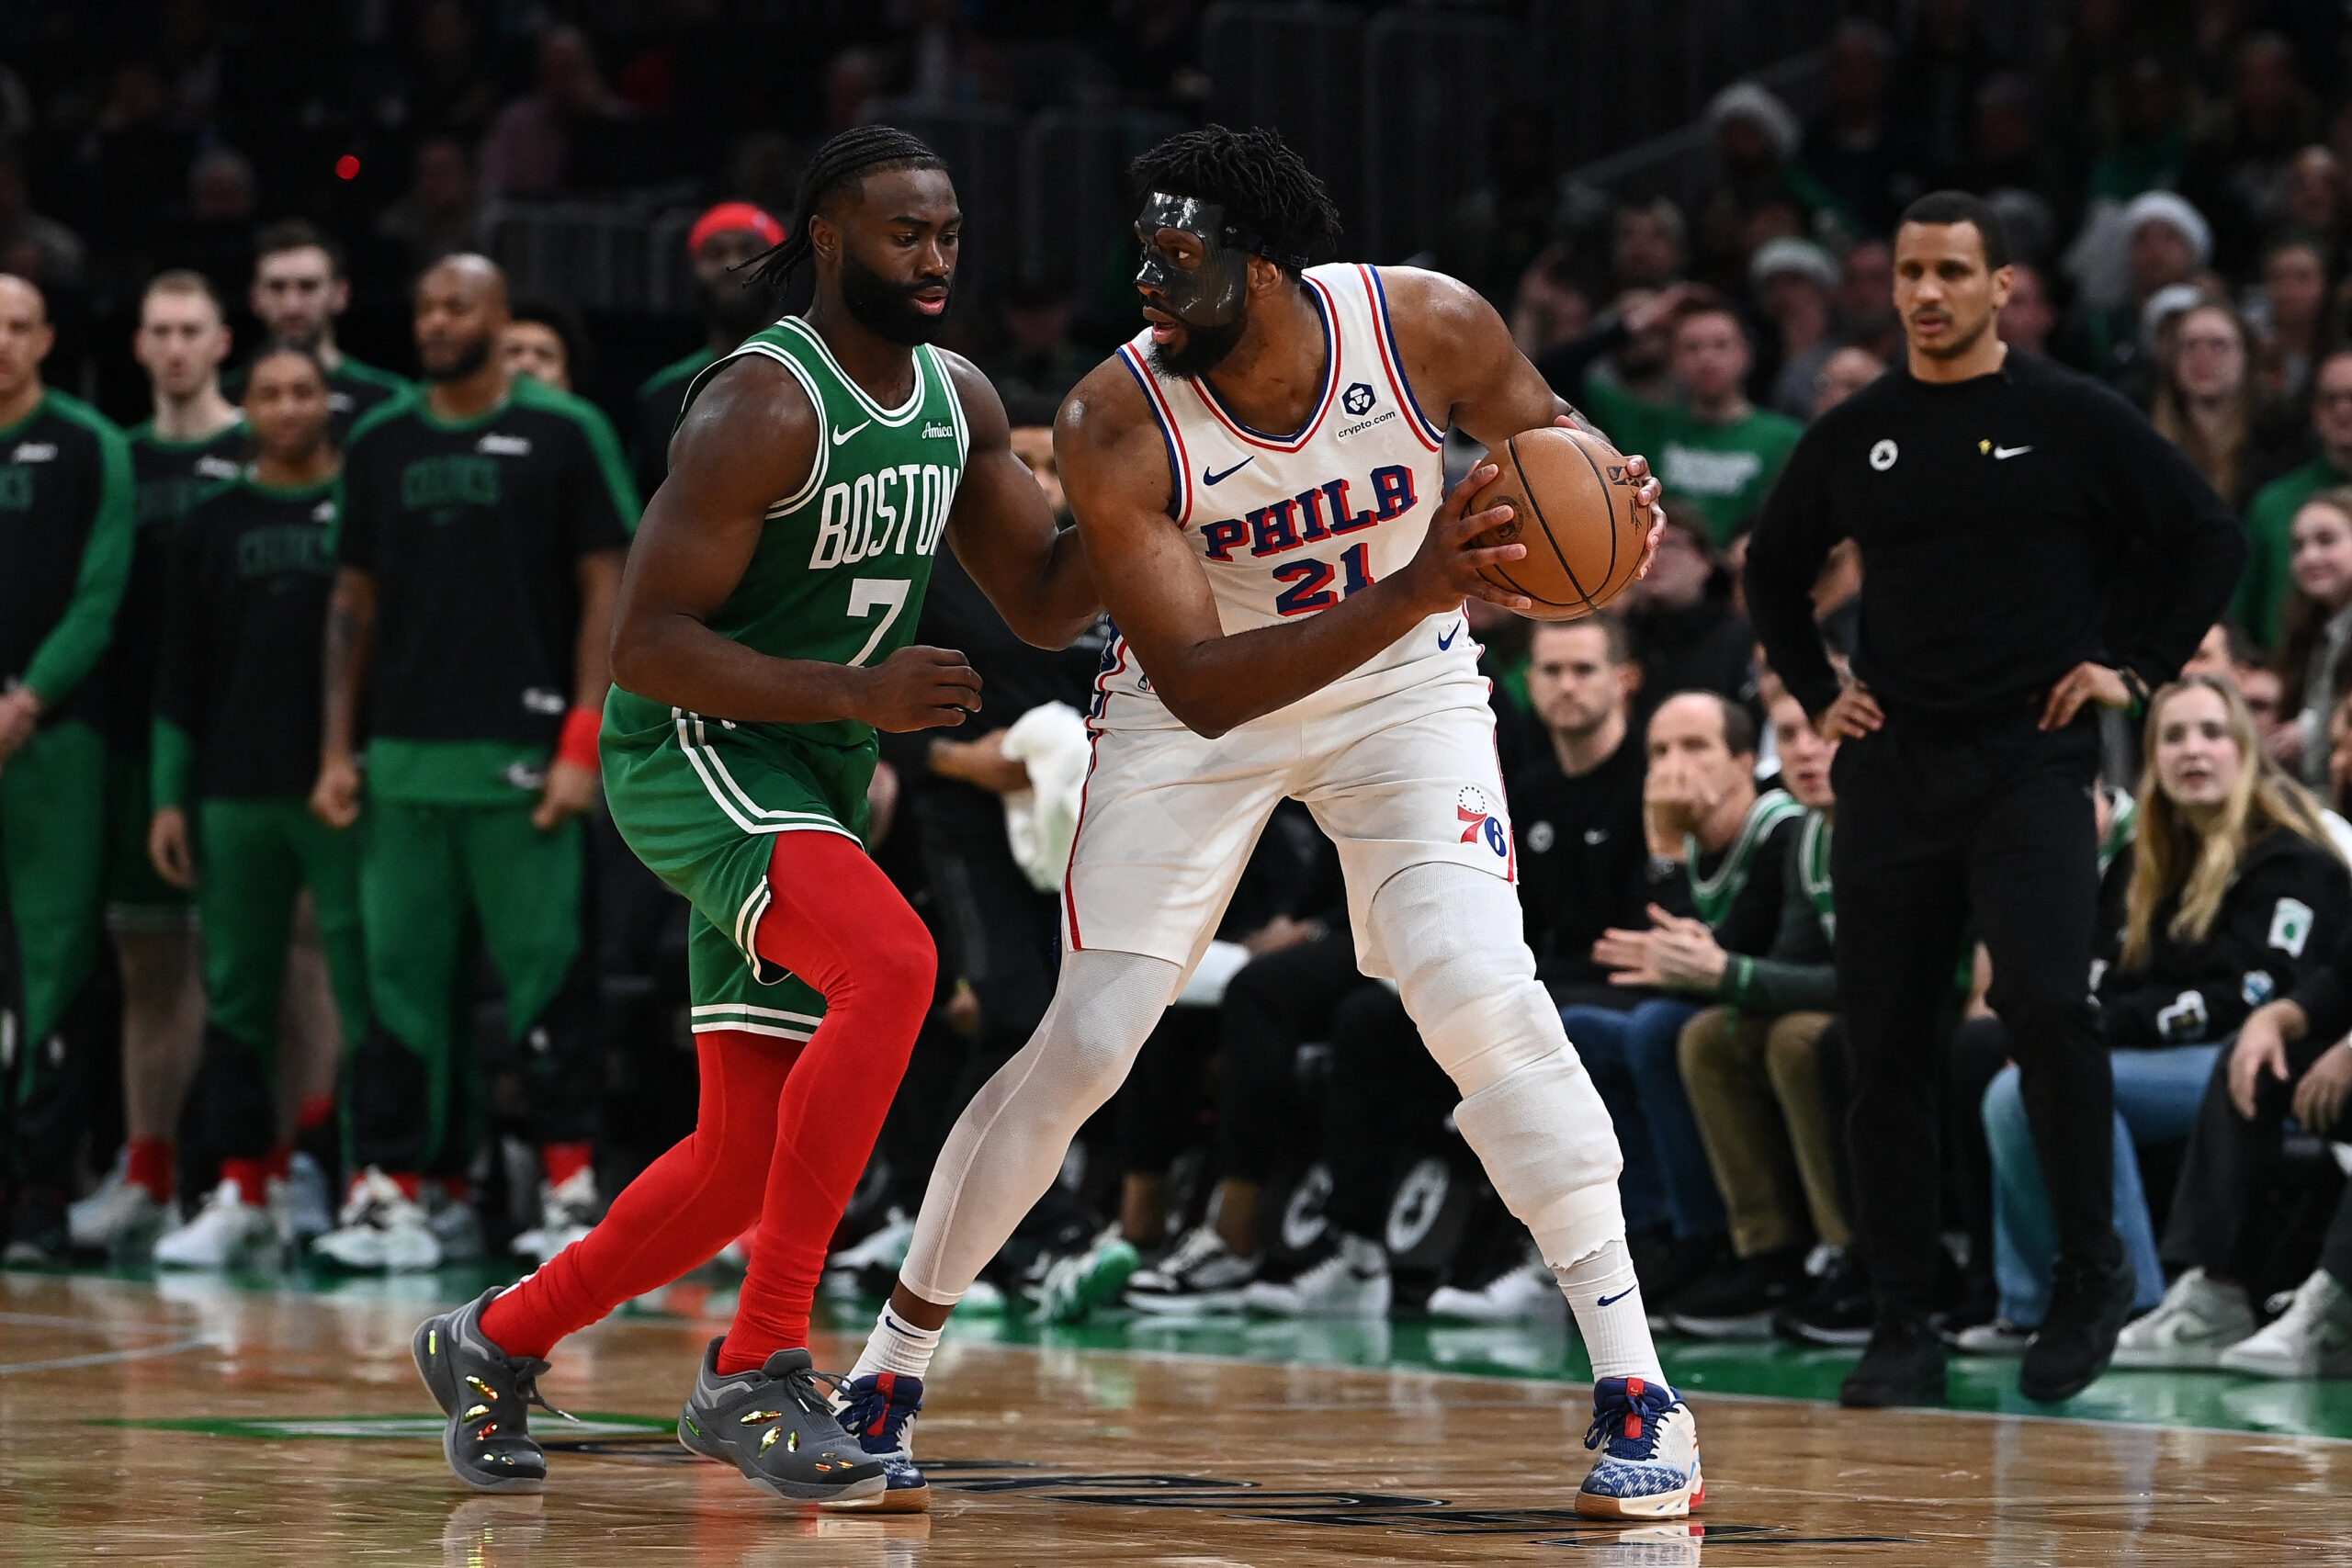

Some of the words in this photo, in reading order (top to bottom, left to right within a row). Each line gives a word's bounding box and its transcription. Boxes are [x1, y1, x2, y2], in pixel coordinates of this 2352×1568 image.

[922, 421, 954, 440] Amica
[1338, 410, 1396, 439] crypto.com
[808, 463, 959, 570] BOSTON
[1200, 464, 1419, 562] PHILA
[1272, 542, 1375, 617] 21
[846, 578, 912, 668] 7
[1456, 804, 1508, 858] 76
